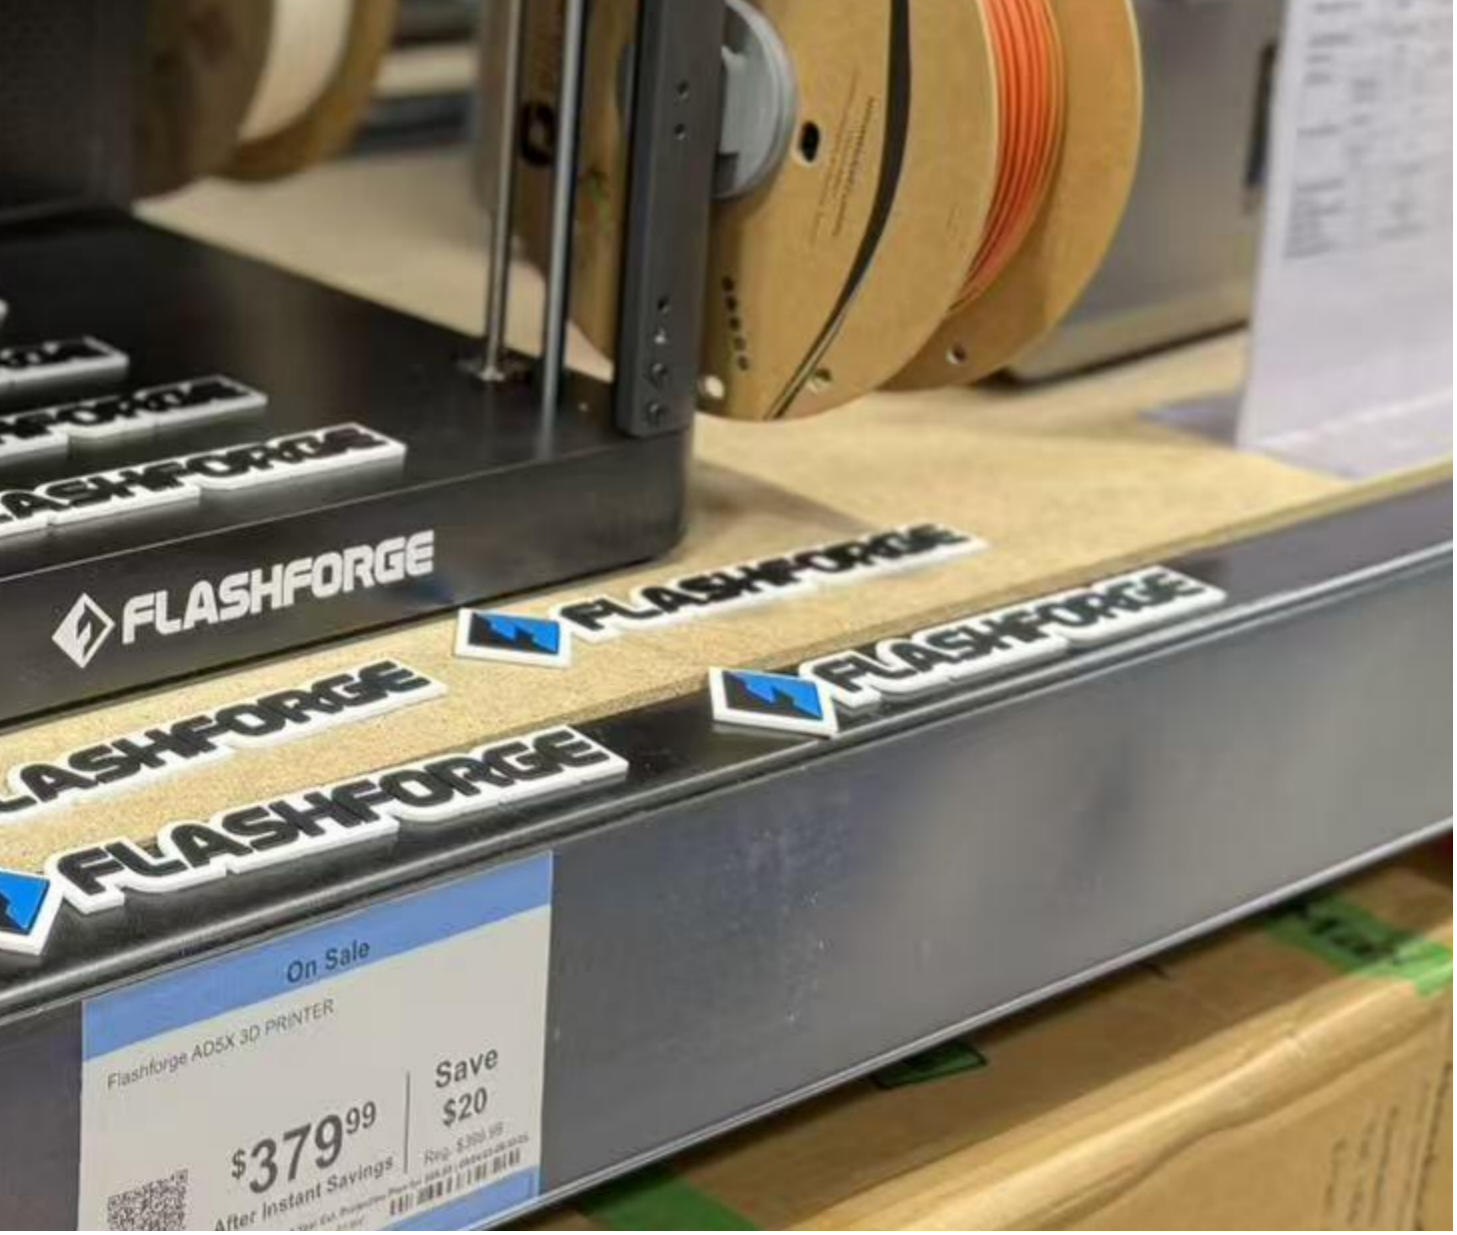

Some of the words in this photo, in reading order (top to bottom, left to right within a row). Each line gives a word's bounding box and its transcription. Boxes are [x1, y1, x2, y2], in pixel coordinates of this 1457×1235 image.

[122, 529, 435, 645] FLASHFORGE
[560, 523, 971, 632] FLASHFORGE
[811, 571, 1207, 695] FLASHFORGE
[57, 730, 610, 896] FLASHFORGE
[286, 959, 317, 983] On
[325, 940, 370, 971] Sale
[107, 1052, 188, 1090] Flashforge
[191, 1034, 235, 1062] AD5X
[240, 1024, 261, 1047] 3D
[265, 999, 335, 1036] PRINTER
[435, 1048, 498, 1088] Save
[443, 1087, 487, 1127] $20
[214, 1211, 256, 1231] After
[262, 1182, 321, 1222] Instant
[326, 1157, 393, 1193] Savings
